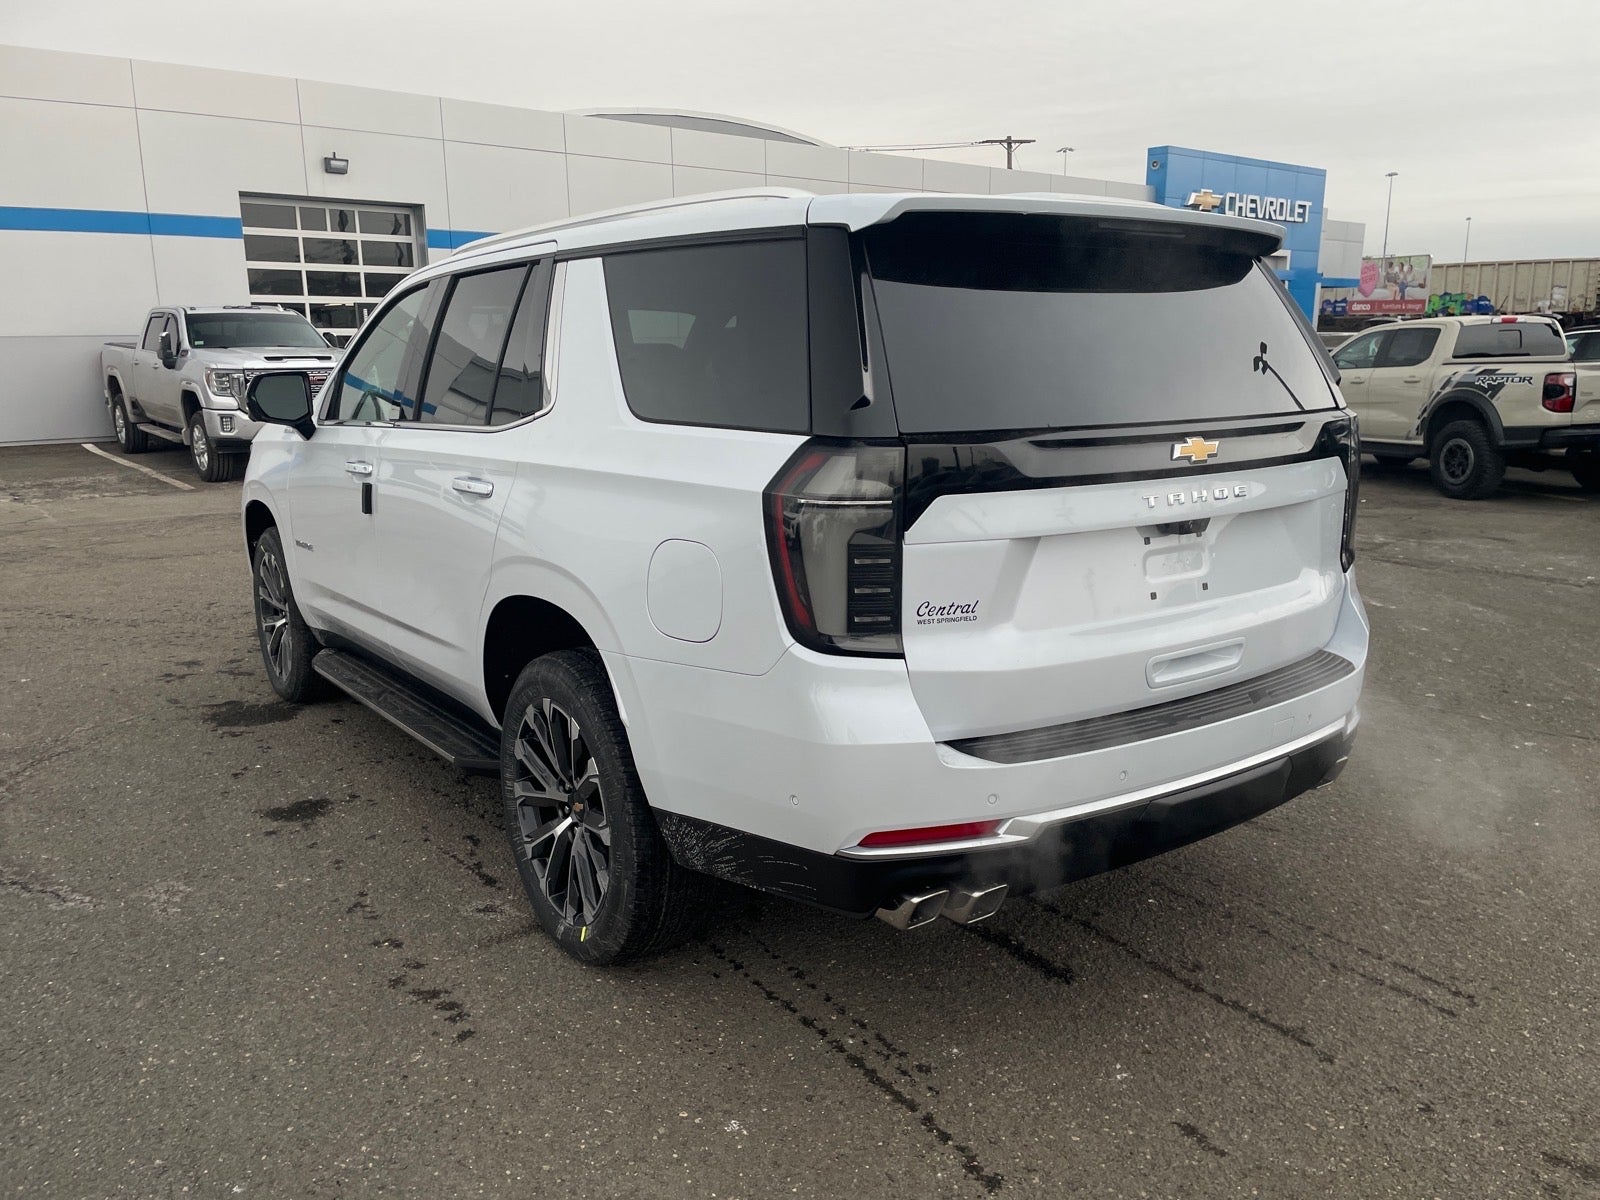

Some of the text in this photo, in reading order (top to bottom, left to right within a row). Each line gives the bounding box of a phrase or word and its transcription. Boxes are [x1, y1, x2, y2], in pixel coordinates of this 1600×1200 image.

[1225, 192, 1312, 223] CHEVROLET
[1475, 376, 1533, 388] RAPTOR
[1142, 485, 1247, 509] TAHOE
[916, 600, 979, 617] Central
[936, 615, 978, 624] SPRINGFIELD
